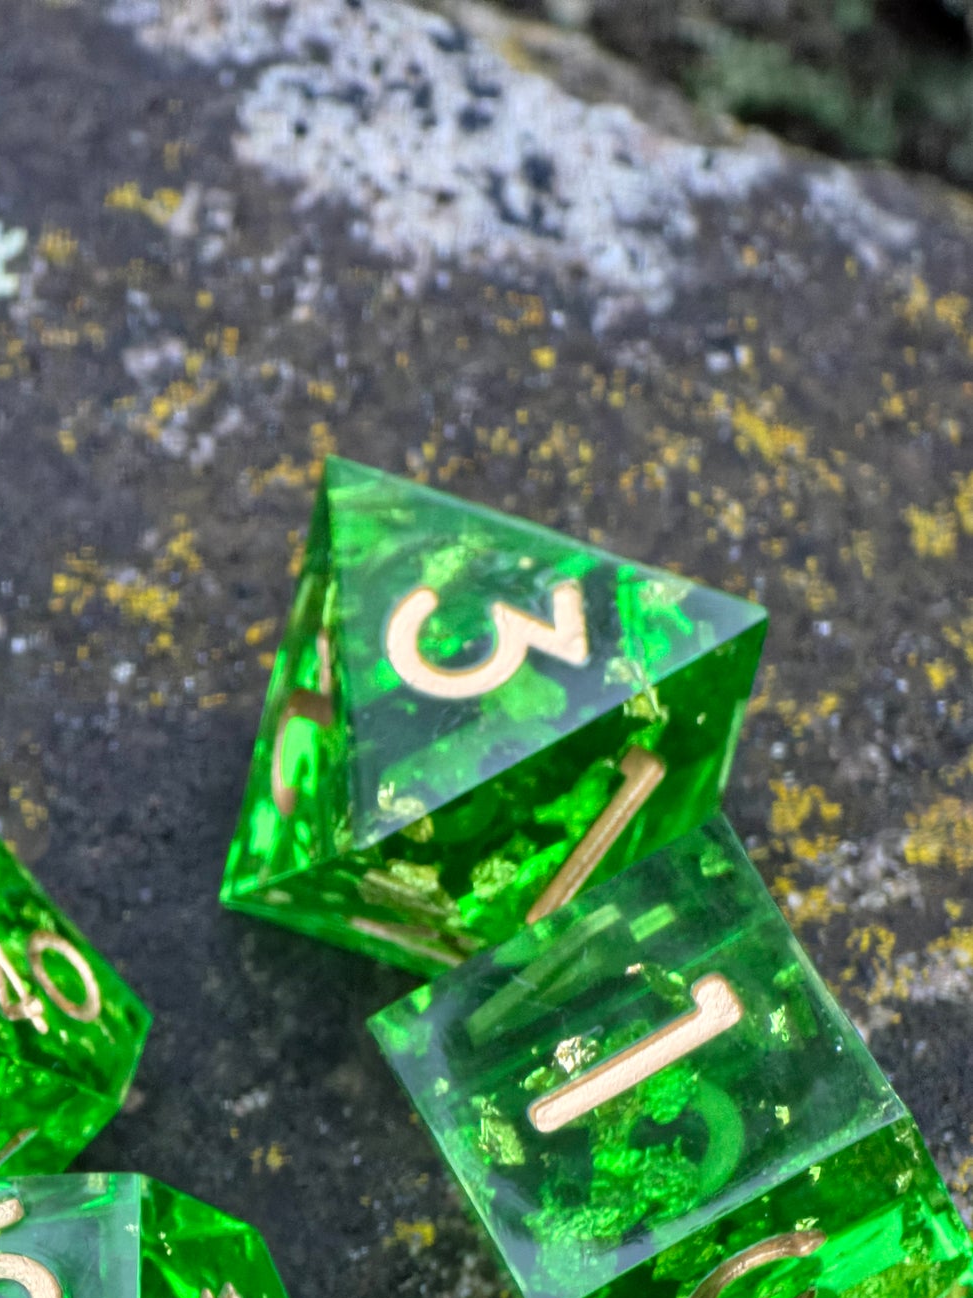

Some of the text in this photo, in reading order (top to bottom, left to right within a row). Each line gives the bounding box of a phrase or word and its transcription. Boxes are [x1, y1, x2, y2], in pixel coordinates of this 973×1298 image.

[386, 585, 589, 699] 3
[528, 745, 665, 923] 1
[529, 974, 743, 1132] 1
